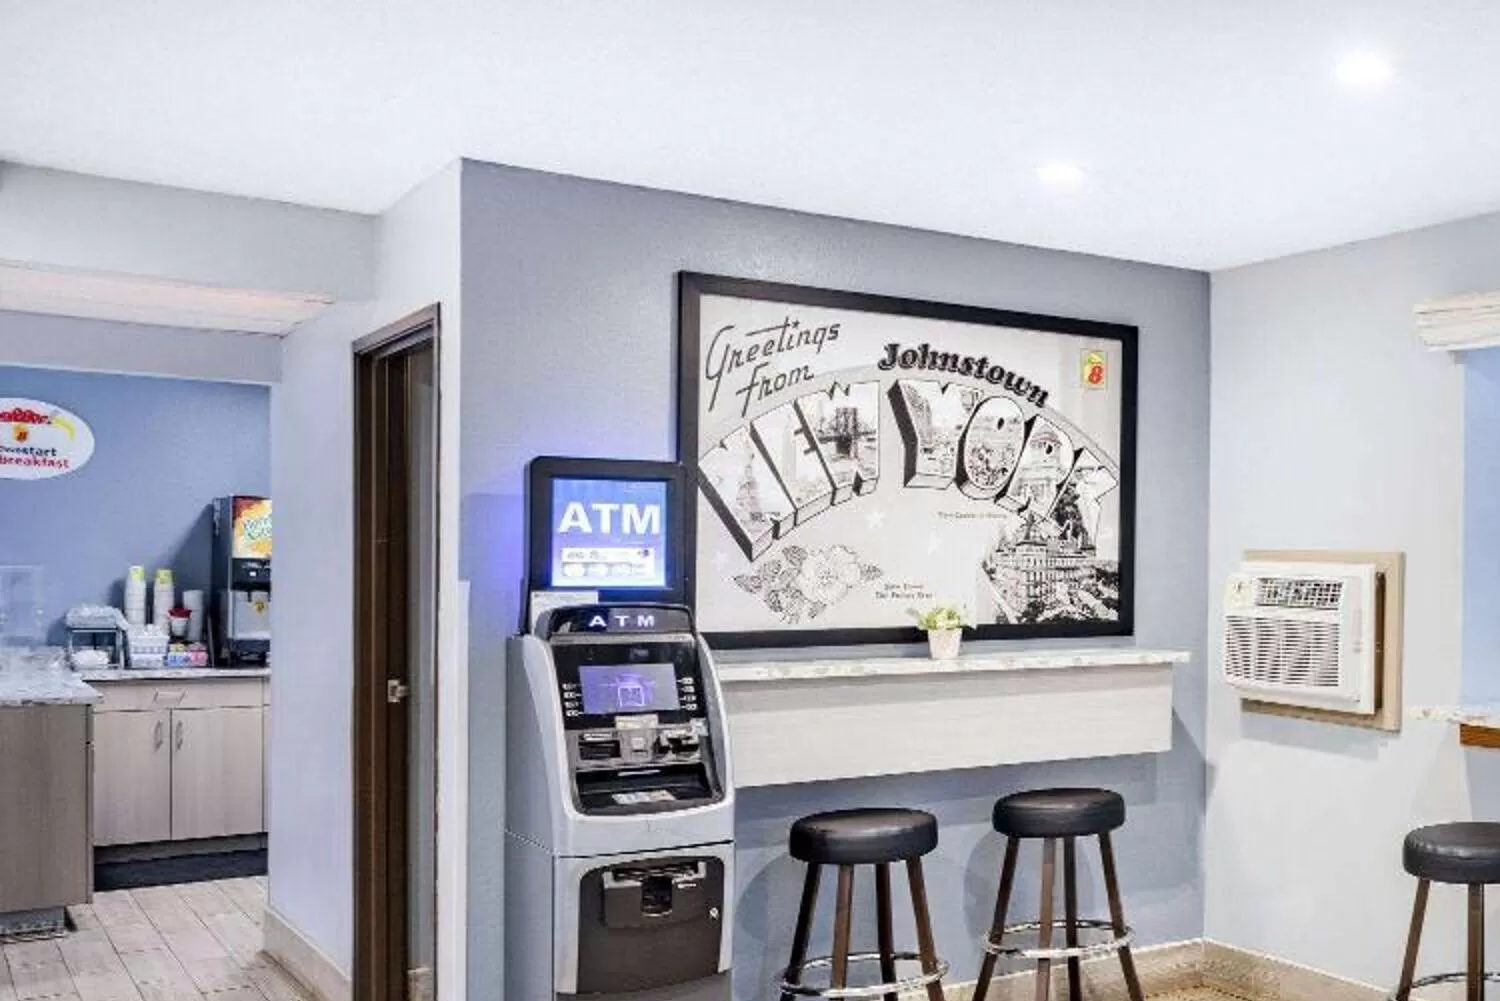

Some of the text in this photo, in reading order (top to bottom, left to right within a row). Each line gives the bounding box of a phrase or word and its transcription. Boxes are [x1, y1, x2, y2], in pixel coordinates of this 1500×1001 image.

[705, 316, 841, 412] Greetings
[877, 343, 1049, 408] Johnstown
[697, 379, 1119, 562] NEW YORK
[557, 501, 661, 536] ATM
[588, 614, 655, 628] ATM
